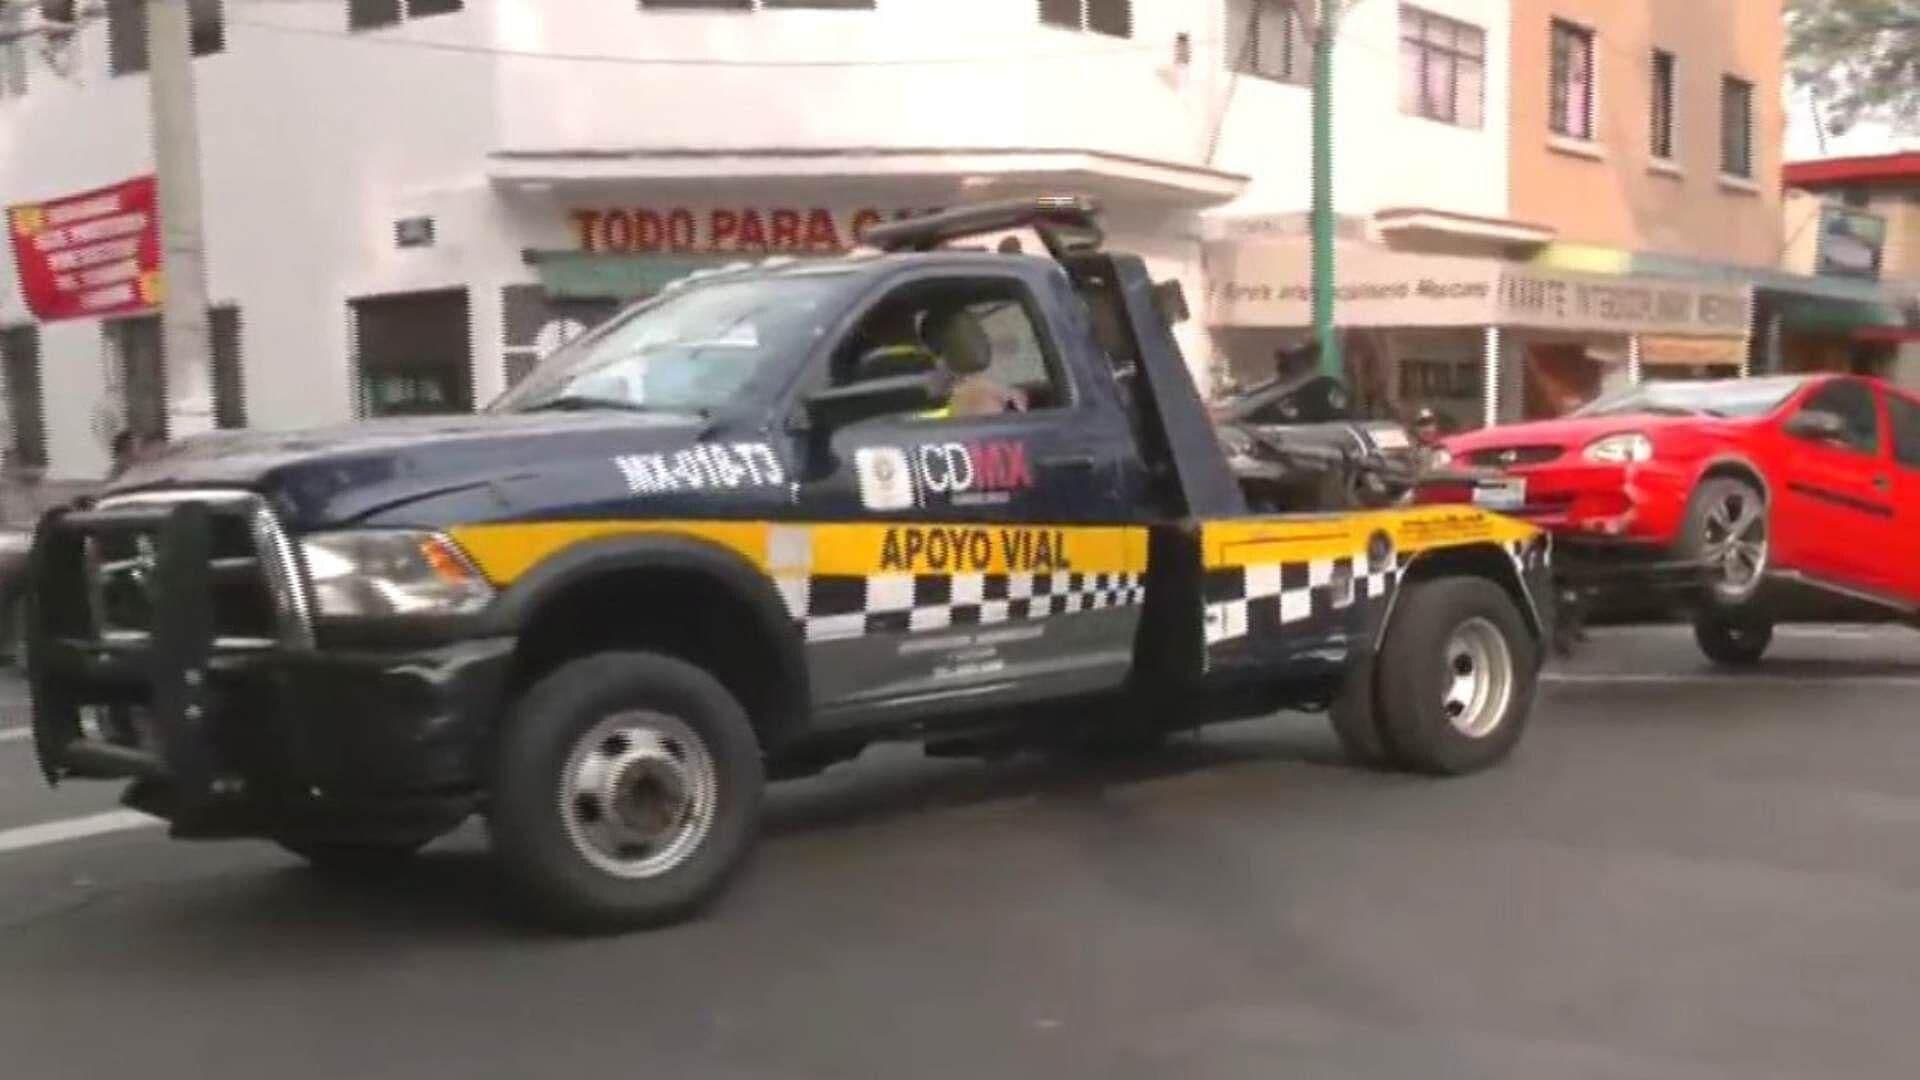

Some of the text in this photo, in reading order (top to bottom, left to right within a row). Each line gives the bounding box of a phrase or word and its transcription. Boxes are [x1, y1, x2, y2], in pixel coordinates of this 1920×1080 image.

[572, 207, 696, 254] TODO
[709, 206, 844, 253] PARA
[920, 440, 1031, 492] CDMX
[879, 527, 1072, 571] APOYO VIAL
